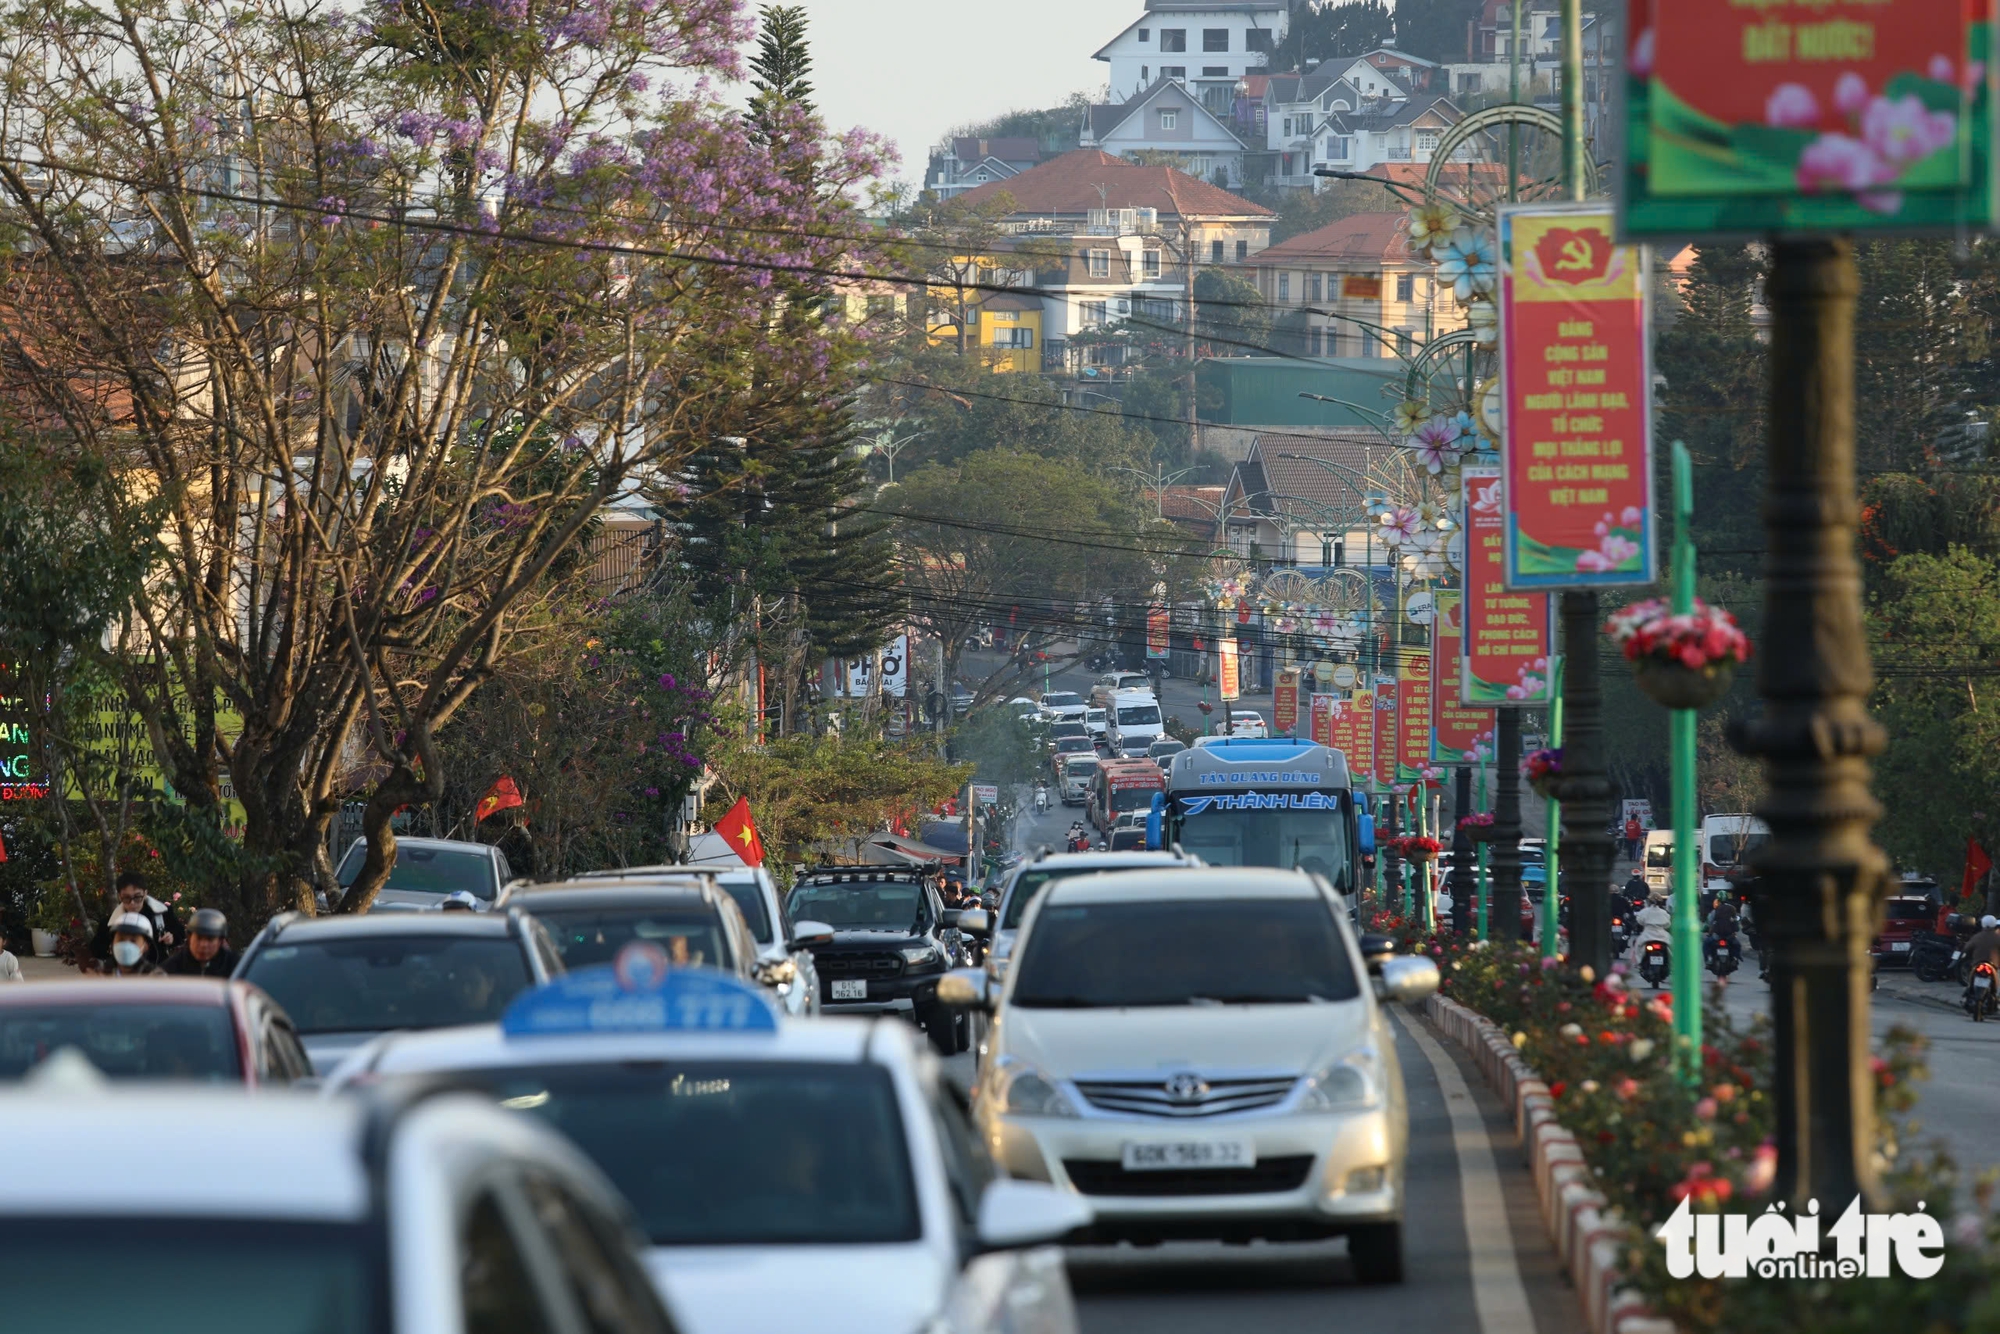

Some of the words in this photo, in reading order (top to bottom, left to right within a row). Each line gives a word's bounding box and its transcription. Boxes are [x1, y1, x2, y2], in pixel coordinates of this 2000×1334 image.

[1558, 317, 1593, 338] ĐẢNG
[1545, 343, 1579, 364] CỘNG
[1582, 340, 1608, 361] SẢN
[1548, 366, 1573, 387] VIỆT
[1576, 369, 1606, 385] NAM
[1525, 391, 1562, 409] NGƯỜI
[1566, 391, 1598, 409] LÃNH
[1549, 485, 1575, 507] VIỆT
[1579, 488, 1608, 504] NAM
[1200, 771, 1227, 784] TÂN
[1230, 772, 1278, 783] QUANG
[1281, 769, 1320, 783] DŨNG
[1214, 790, 1288, 810] THÀNH
[1290, 791, 1338, 810] LIÊN
